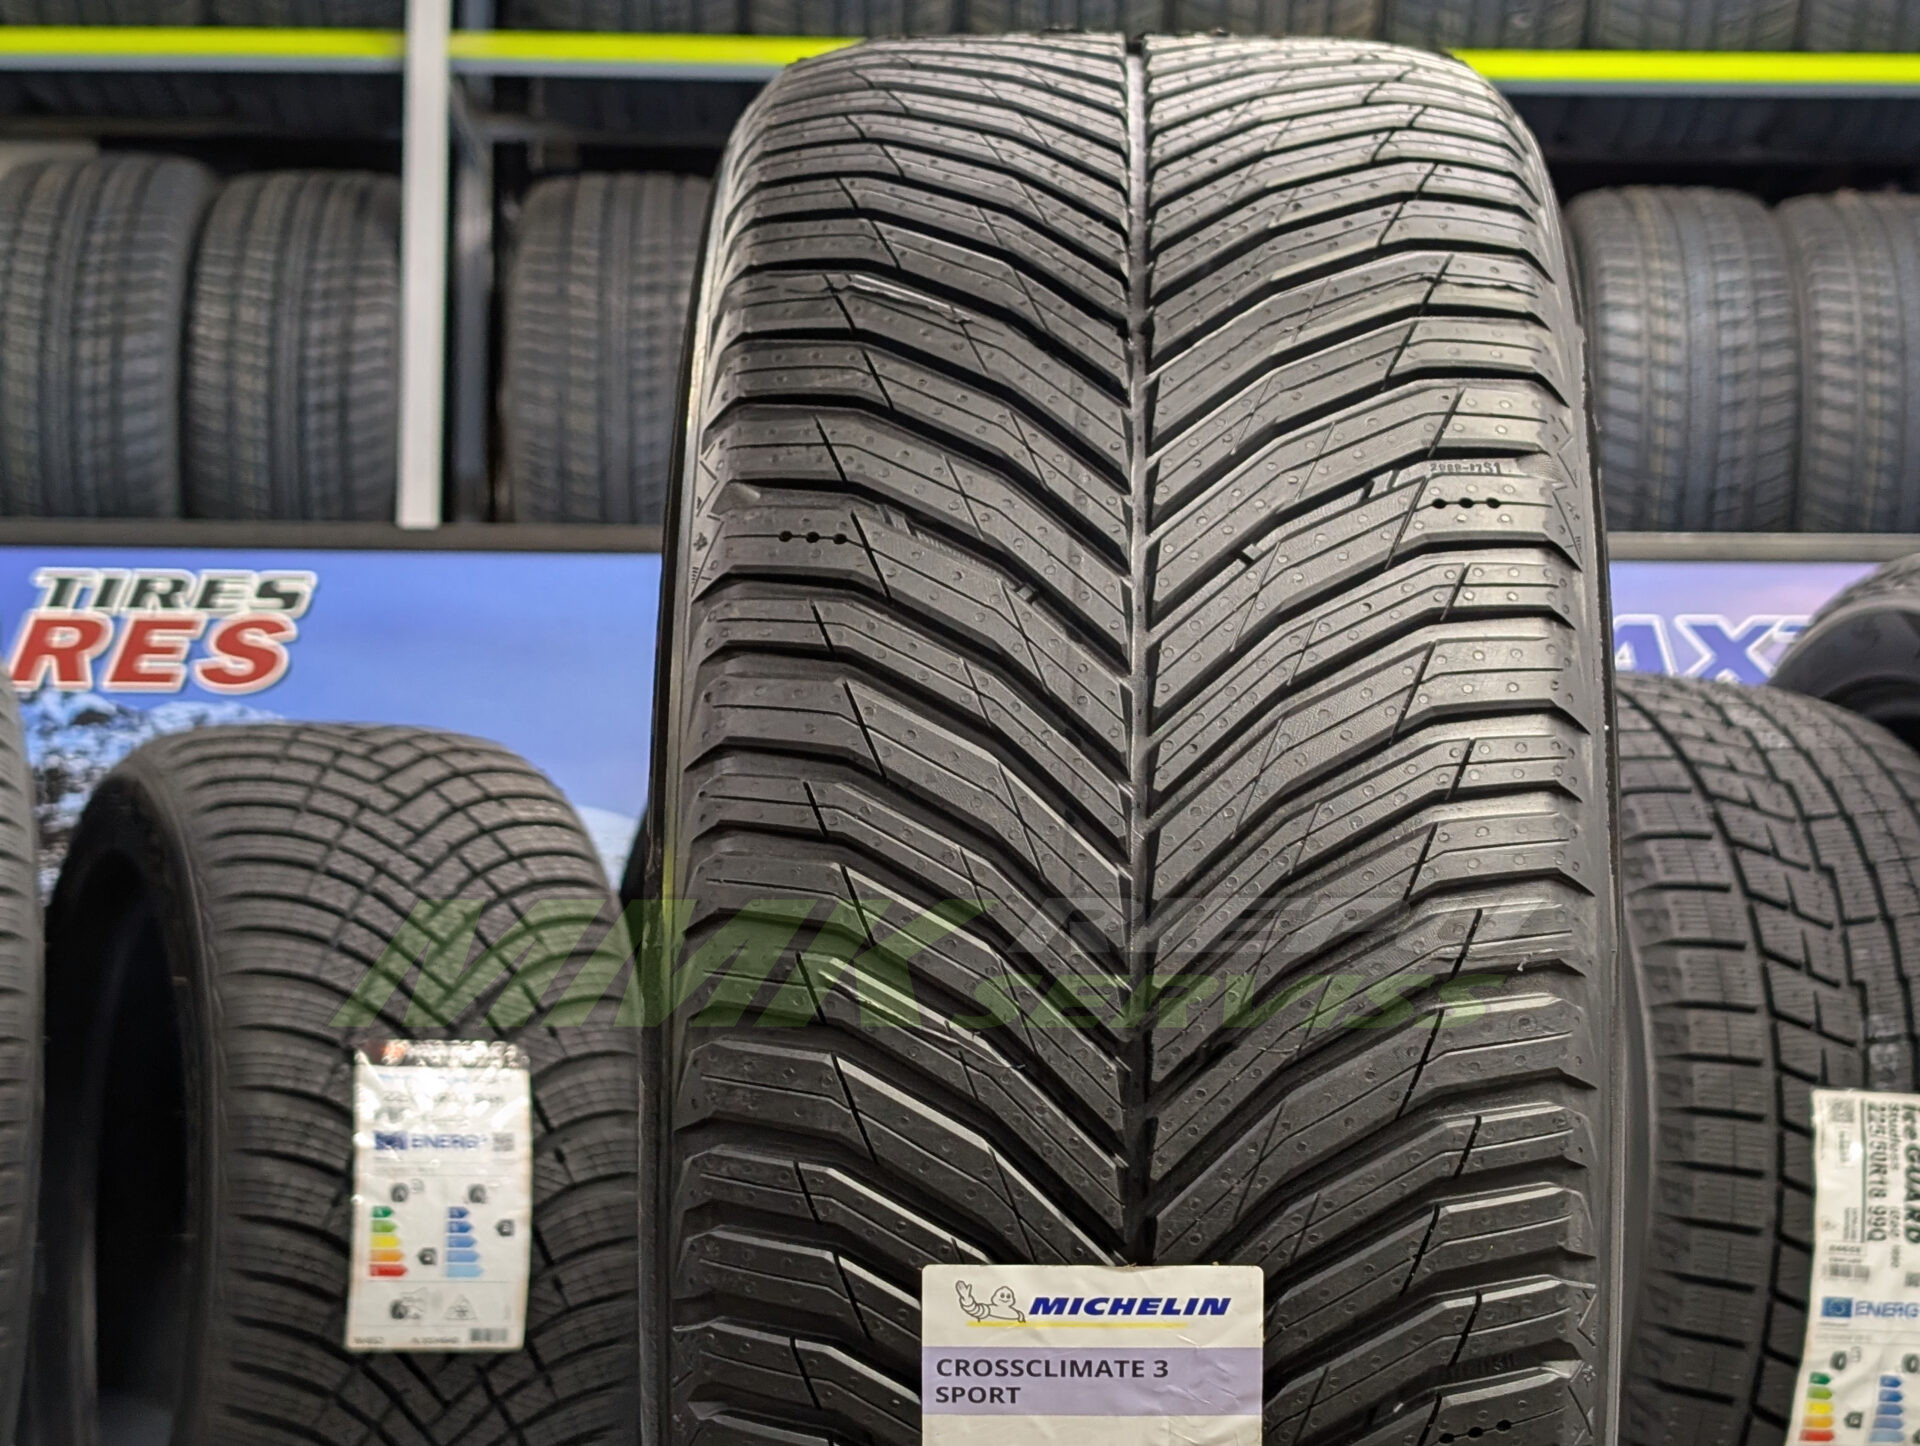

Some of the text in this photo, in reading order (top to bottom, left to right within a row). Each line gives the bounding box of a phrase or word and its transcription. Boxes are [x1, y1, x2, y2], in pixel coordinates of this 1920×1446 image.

[32, 567, 317, 618] TIRES
[1028, 1296, 1232, 1316] MICHELIN
[936, 1358, 1169, 1378] CROSSCLIMATE 3
[935, 1386, 1021, 1404] SPORT
